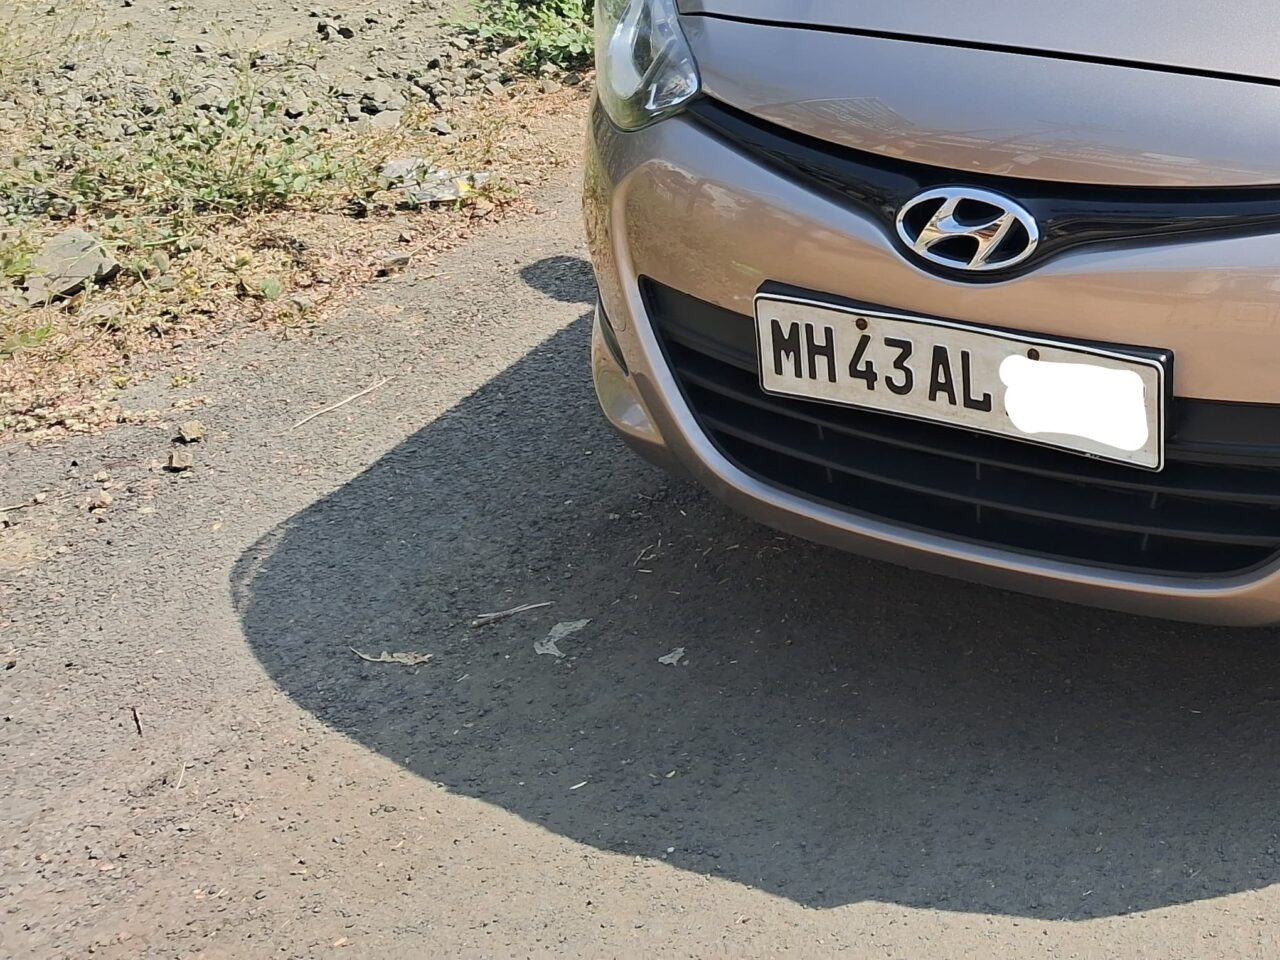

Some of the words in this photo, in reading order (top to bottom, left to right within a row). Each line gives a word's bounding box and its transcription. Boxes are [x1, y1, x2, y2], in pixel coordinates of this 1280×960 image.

[771, 319, 836, 383] MH
[848, 334, 913, 395] 43
[928, 345, 991, 412] AL
